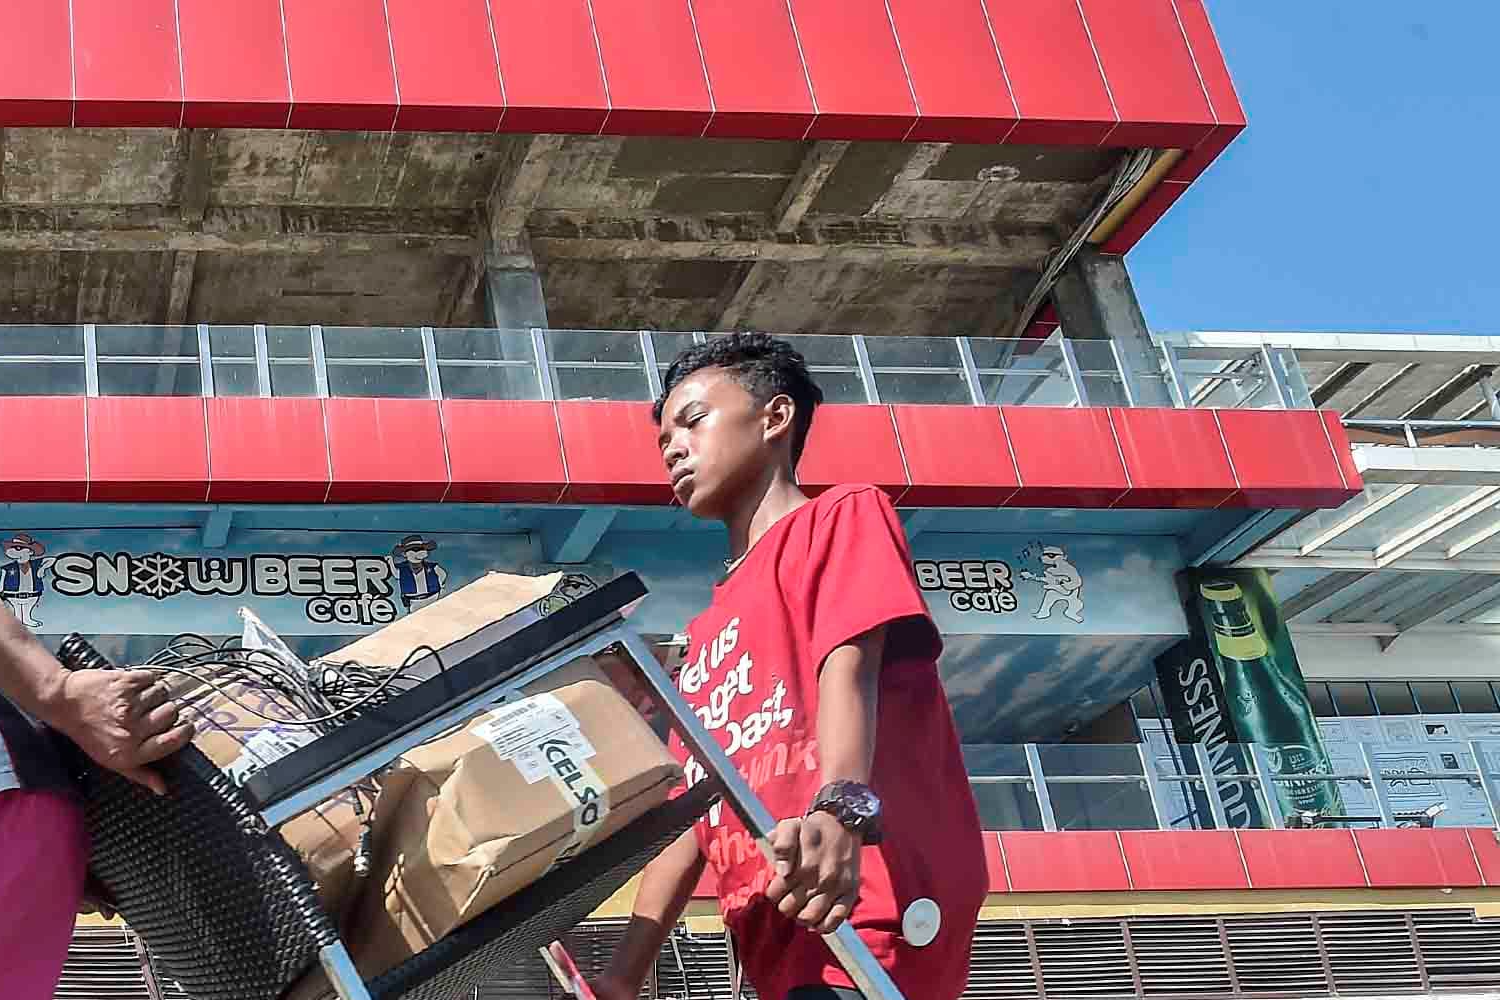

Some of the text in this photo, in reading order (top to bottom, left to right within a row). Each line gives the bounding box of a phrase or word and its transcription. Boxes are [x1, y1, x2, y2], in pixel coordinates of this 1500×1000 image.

[252, 554, 391, 596] BEER
[913, 561, 1012, 589] BEER
[711, 617, 740, 669] us
[1179, 658, 1250, 829] GUINNESS
